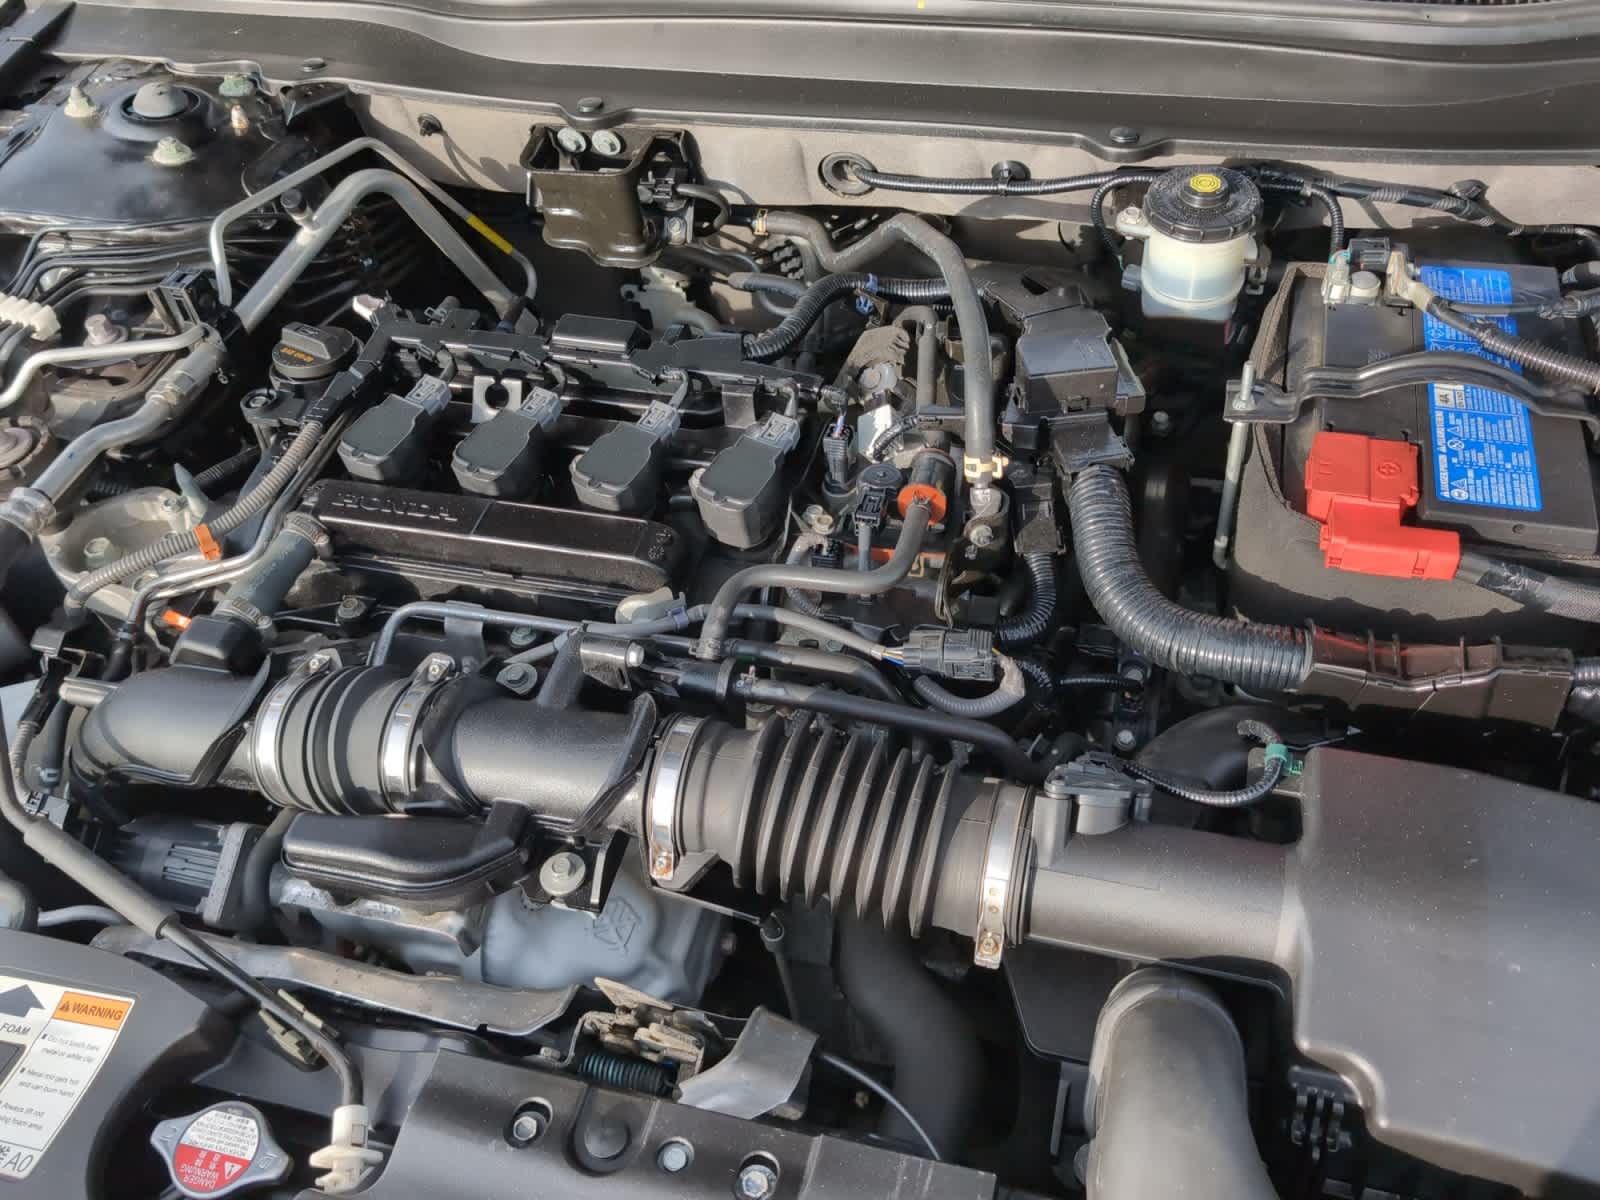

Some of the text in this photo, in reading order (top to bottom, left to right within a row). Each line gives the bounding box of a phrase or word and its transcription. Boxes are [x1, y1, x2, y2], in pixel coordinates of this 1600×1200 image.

[332, 493, 458, 521] HONDA
[72, 1002, 124, 1021] WARNING
[1, 1022, 31, 1036] FOAM
[2, 1151, 34, 1173] A0
[180, 1163, 220, 1181] WARNING
[183, 1174, 216, 1190] DANGER
